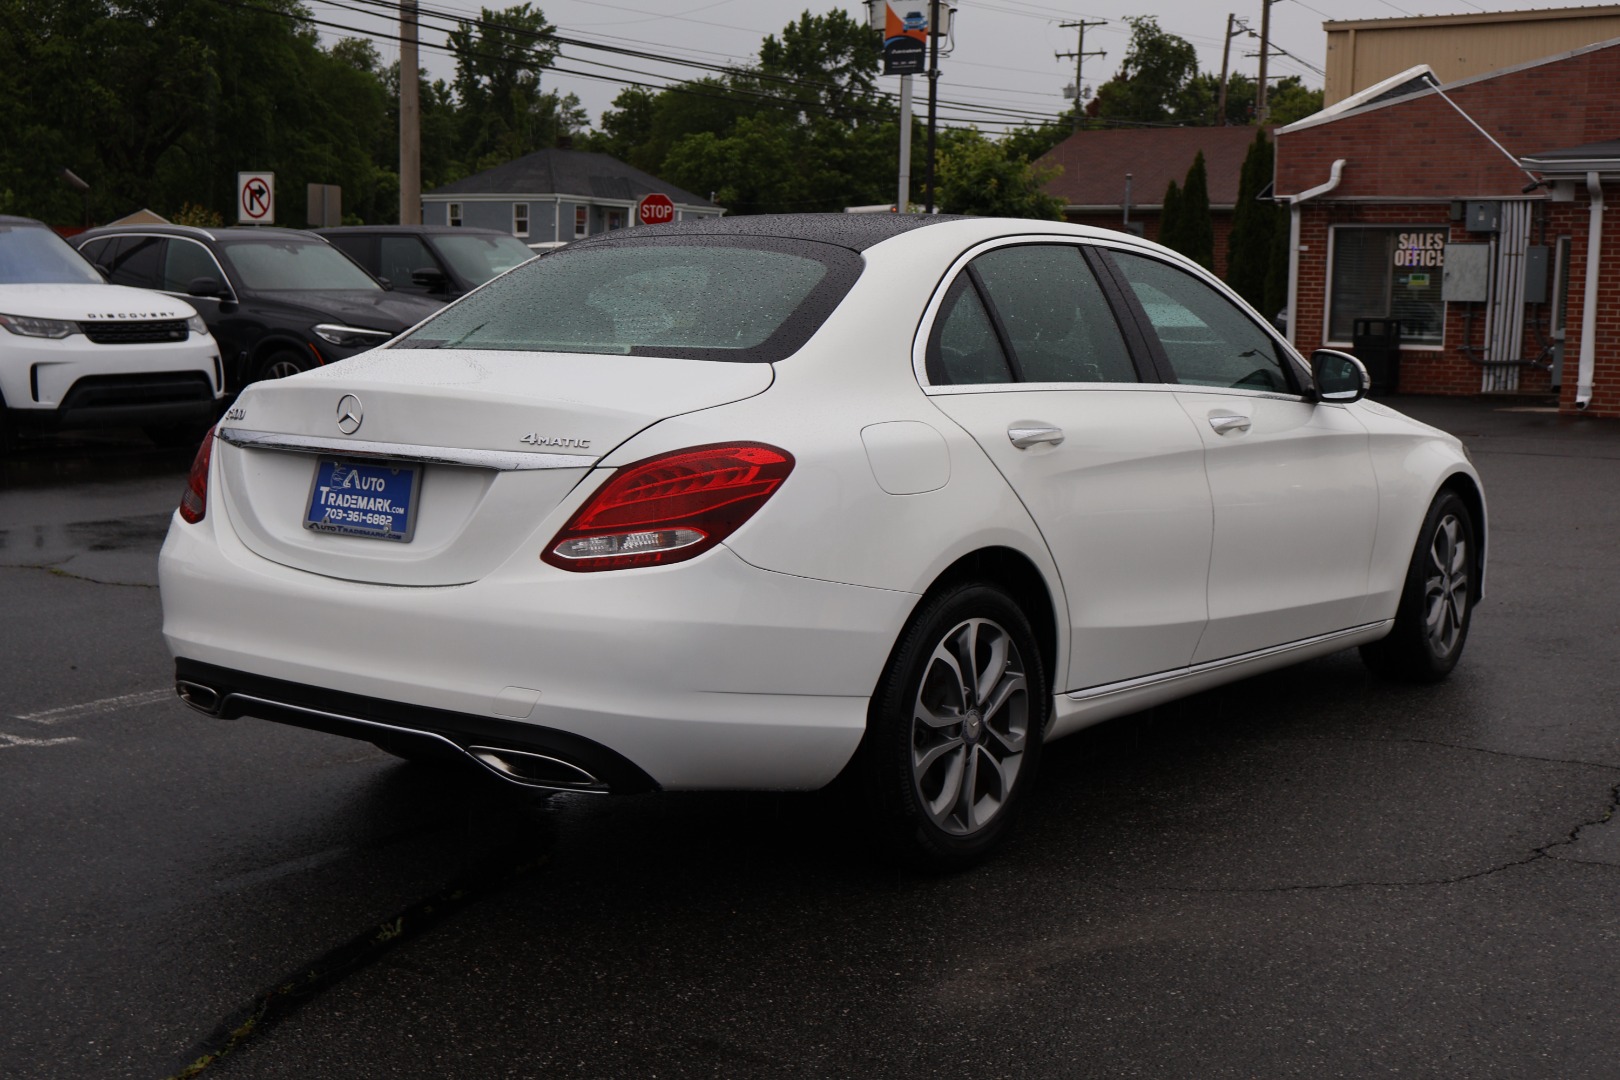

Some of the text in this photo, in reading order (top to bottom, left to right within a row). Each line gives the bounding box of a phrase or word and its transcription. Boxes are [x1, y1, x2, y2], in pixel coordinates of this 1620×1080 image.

[642, 204, 672, 218] STOP
[1398, 233, 1444, 249] SALES
[87, 311, 176, 319] DISCOVERY
[520, 432, 591, 449] 4MATIC
[342, 469, 385, 492] AUTO
